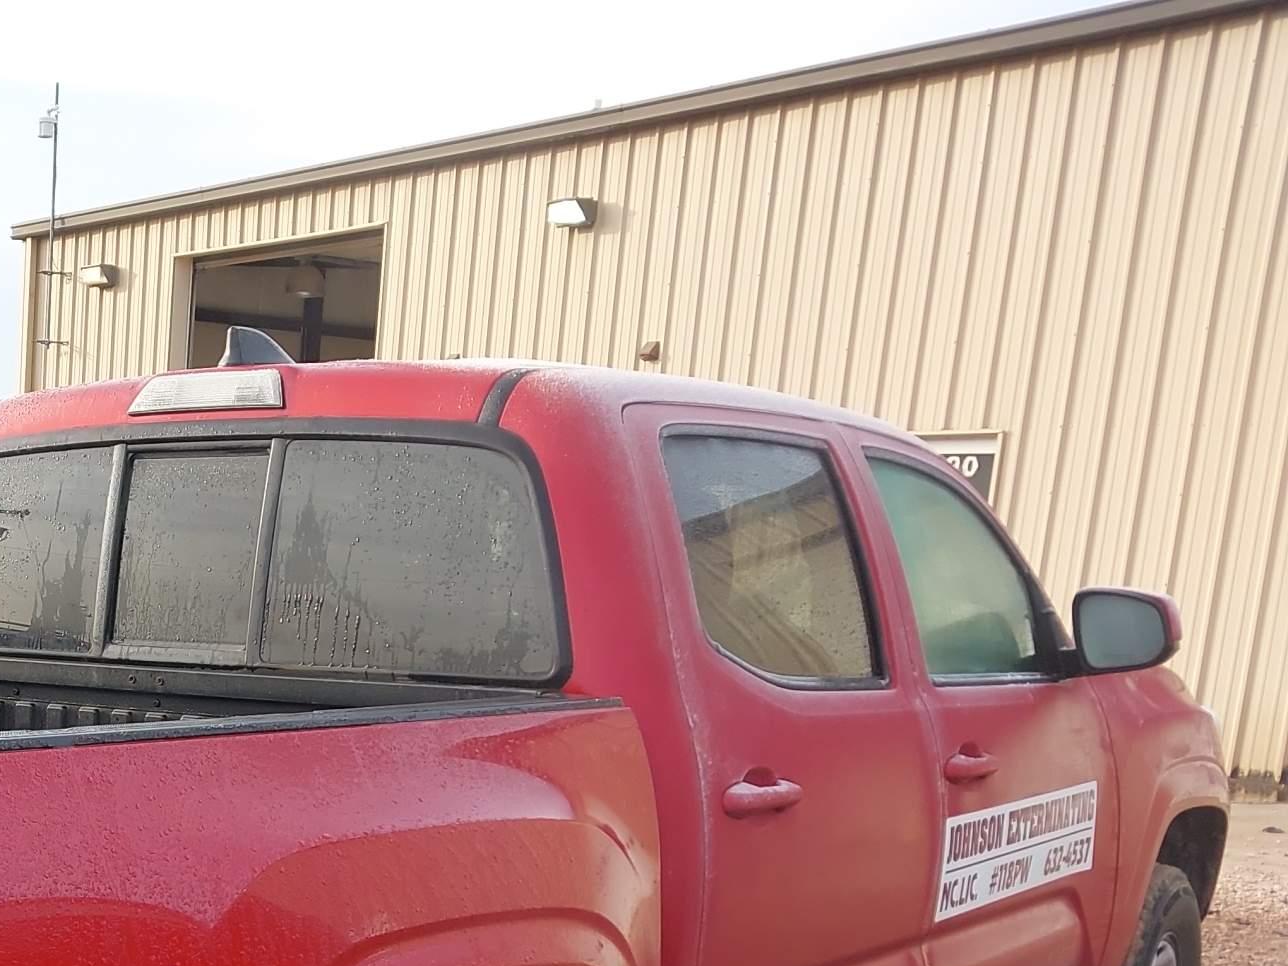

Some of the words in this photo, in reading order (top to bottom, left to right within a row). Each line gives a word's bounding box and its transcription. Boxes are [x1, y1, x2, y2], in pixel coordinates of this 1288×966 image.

[946, 812, 1005, 865] JOHNSON
[1006, 788, 1095, 846] EXTERMINATING
[989, 854, 1032, 896] #118PW
[1043, 836, 1092, 877] 632-4537
